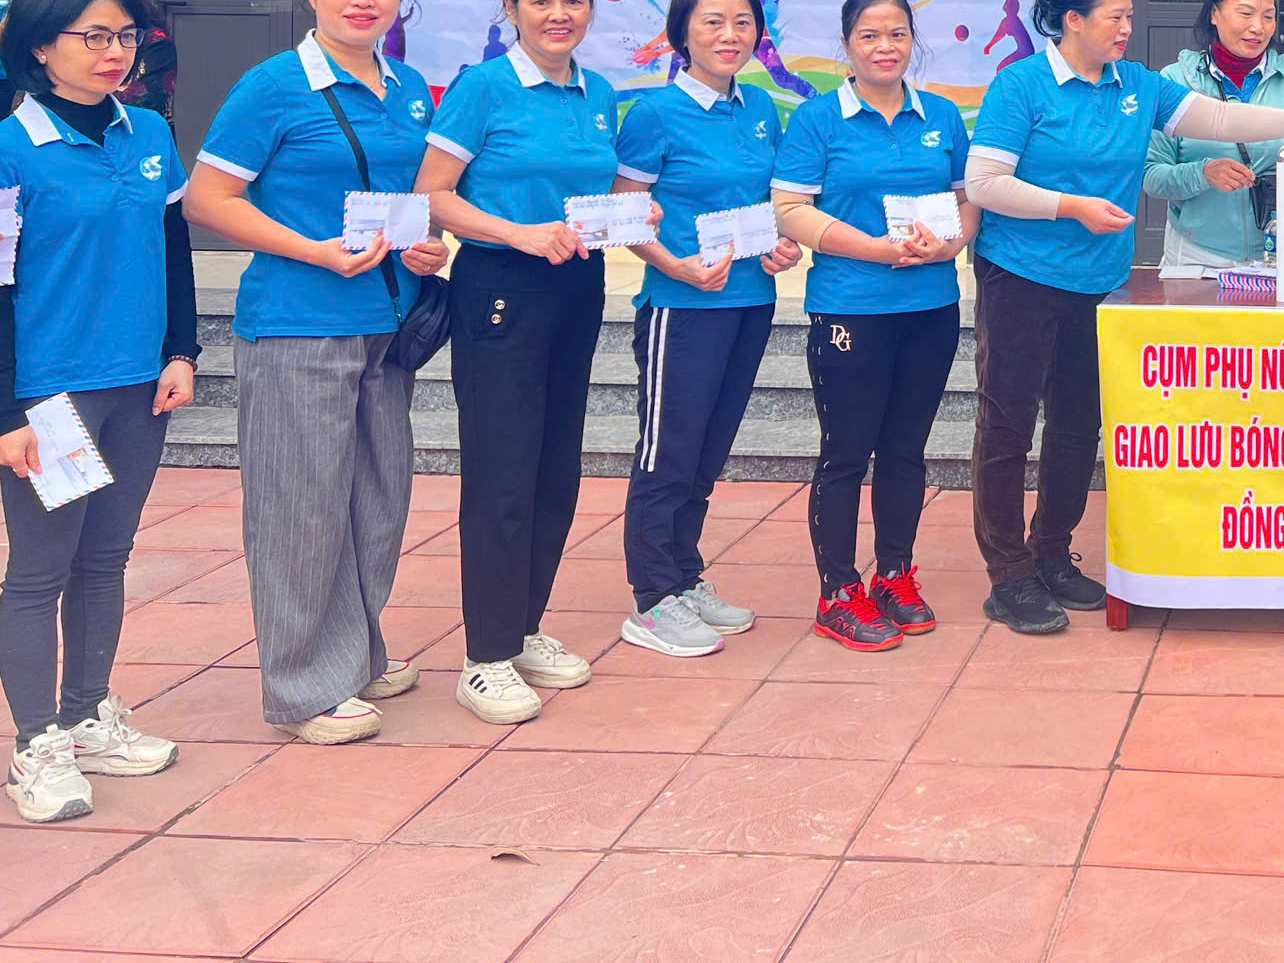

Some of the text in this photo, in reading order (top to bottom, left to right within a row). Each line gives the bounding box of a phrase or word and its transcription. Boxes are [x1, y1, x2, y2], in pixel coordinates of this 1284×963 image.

[1143, 345, 1197, 397] CỤM
[1204, 347, 1253, 399] PHỤ
[1114, 424, 1168, 468] GIAO
[1177, 420, 1222, 468] LƯU
